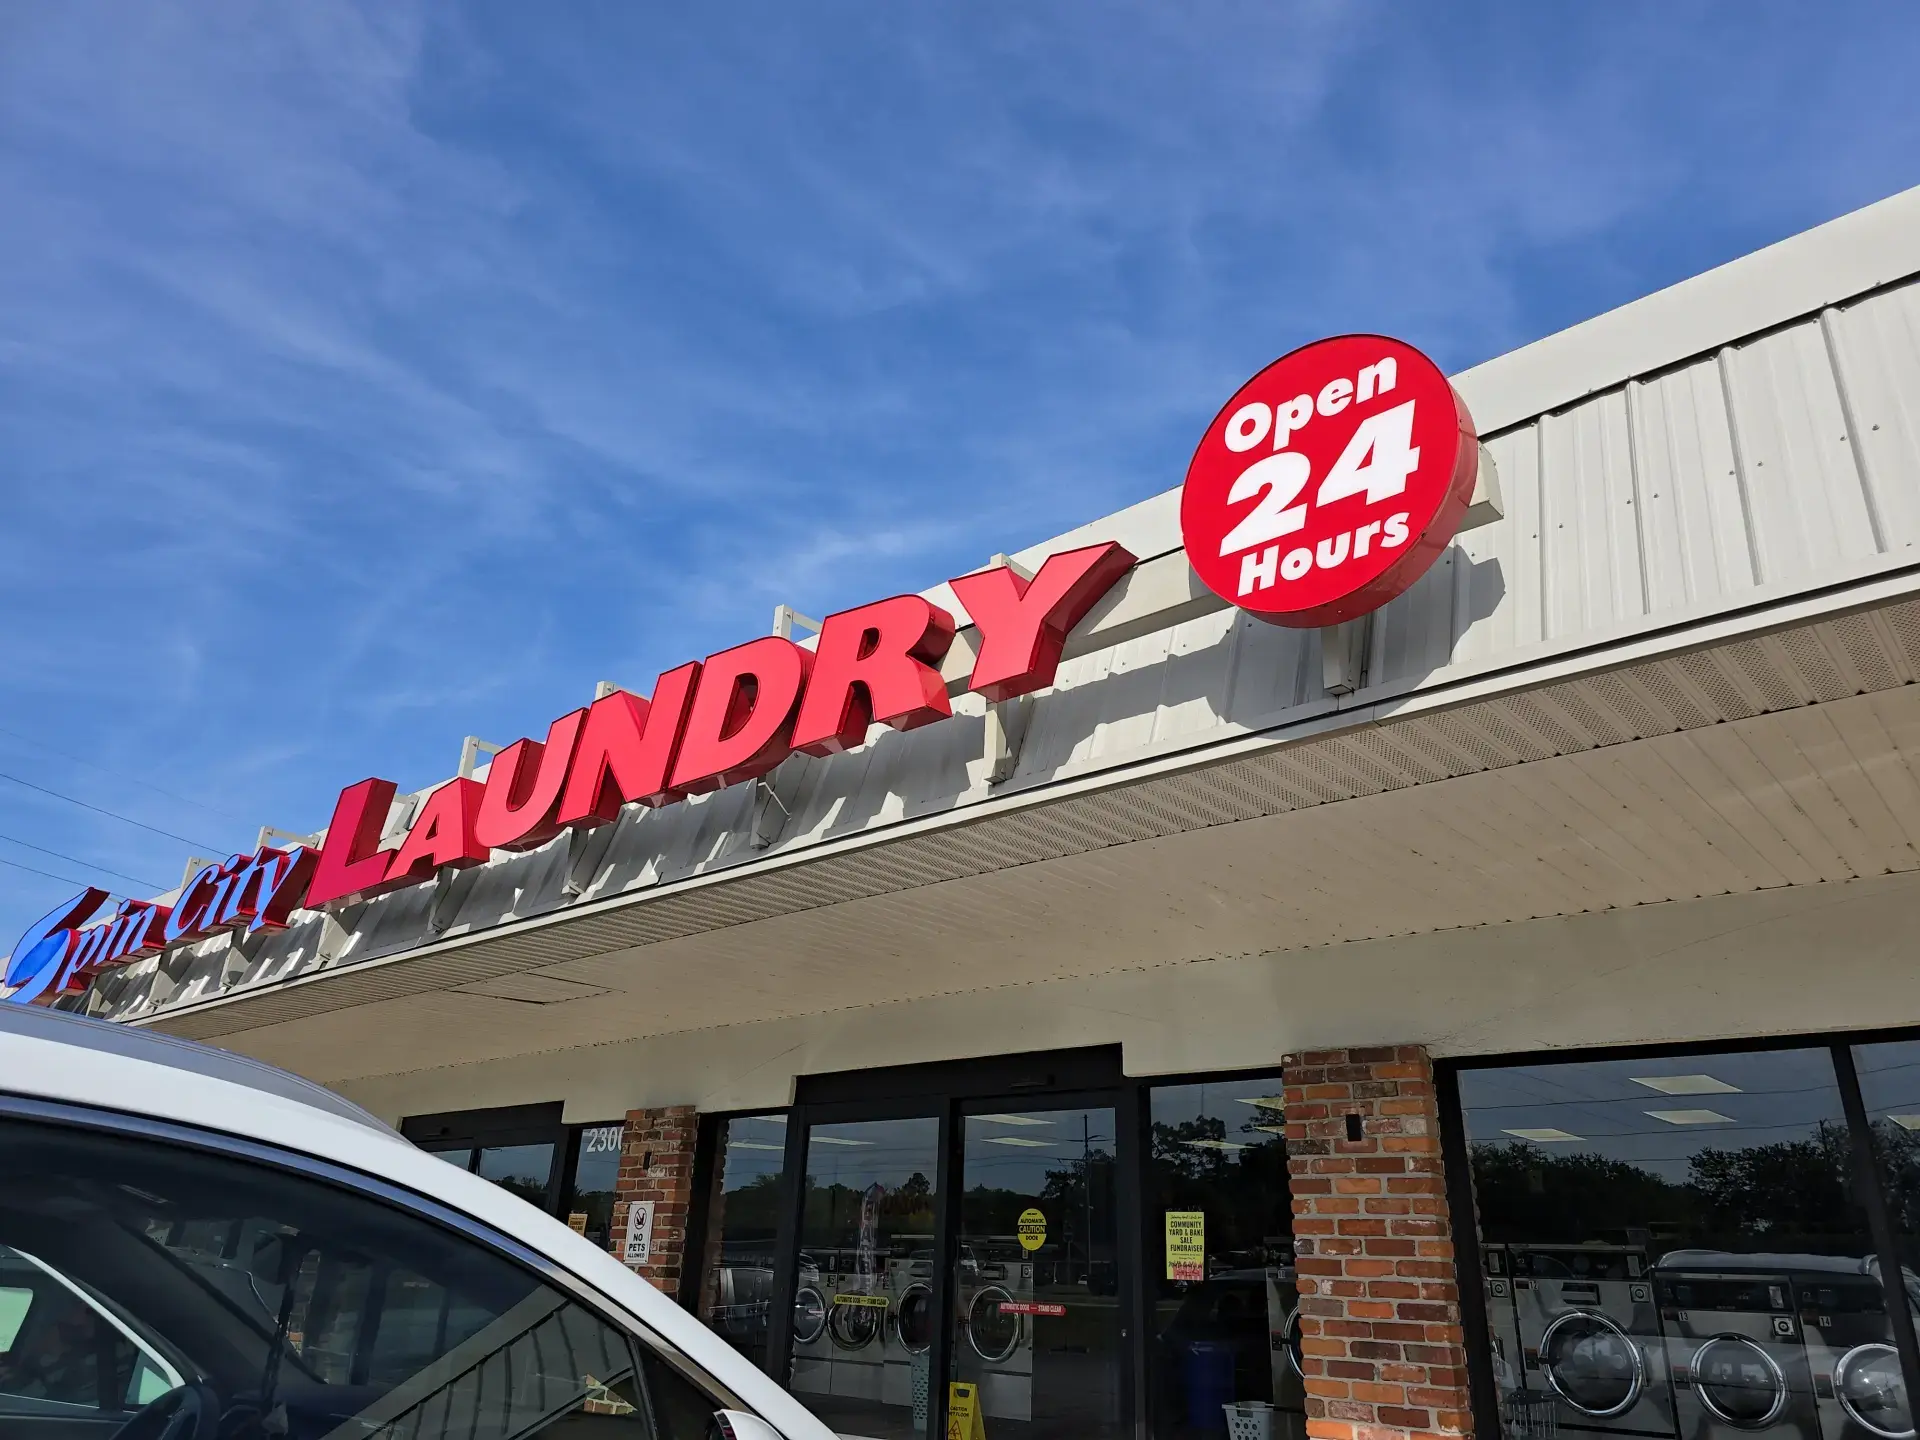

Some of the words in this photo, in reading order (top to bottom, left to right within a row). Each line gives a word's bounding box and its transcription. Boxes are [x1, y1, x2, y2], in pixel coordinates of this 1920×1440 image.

[1224, 356, 1397, 452] Open
[1219, 399, 1421, 557] 24
[1237, 512, 1410, 598] Hours
[1, 887, 168, 1005] Spin
[164, 845, 310, 943] City
[304, 541, 1132, 910] LAUNDRY
[1018, 1225, 1046, 1233] CAUTION
[633, 1233, 643, 1242] NO
[628, 1243, 646, 1252] PETS
[1000, 1302, 1019, 1310] AUTOMATIC
[1020, 1303, 1030, 1311] DOOR
[1038, 1304, 1050, 1312] STAND
[1050, 1305, 1062, 1313] CLEAR
[1679, 1312, 1688, 1321] 13
[1820, 1317, 1830, 1326] 14
